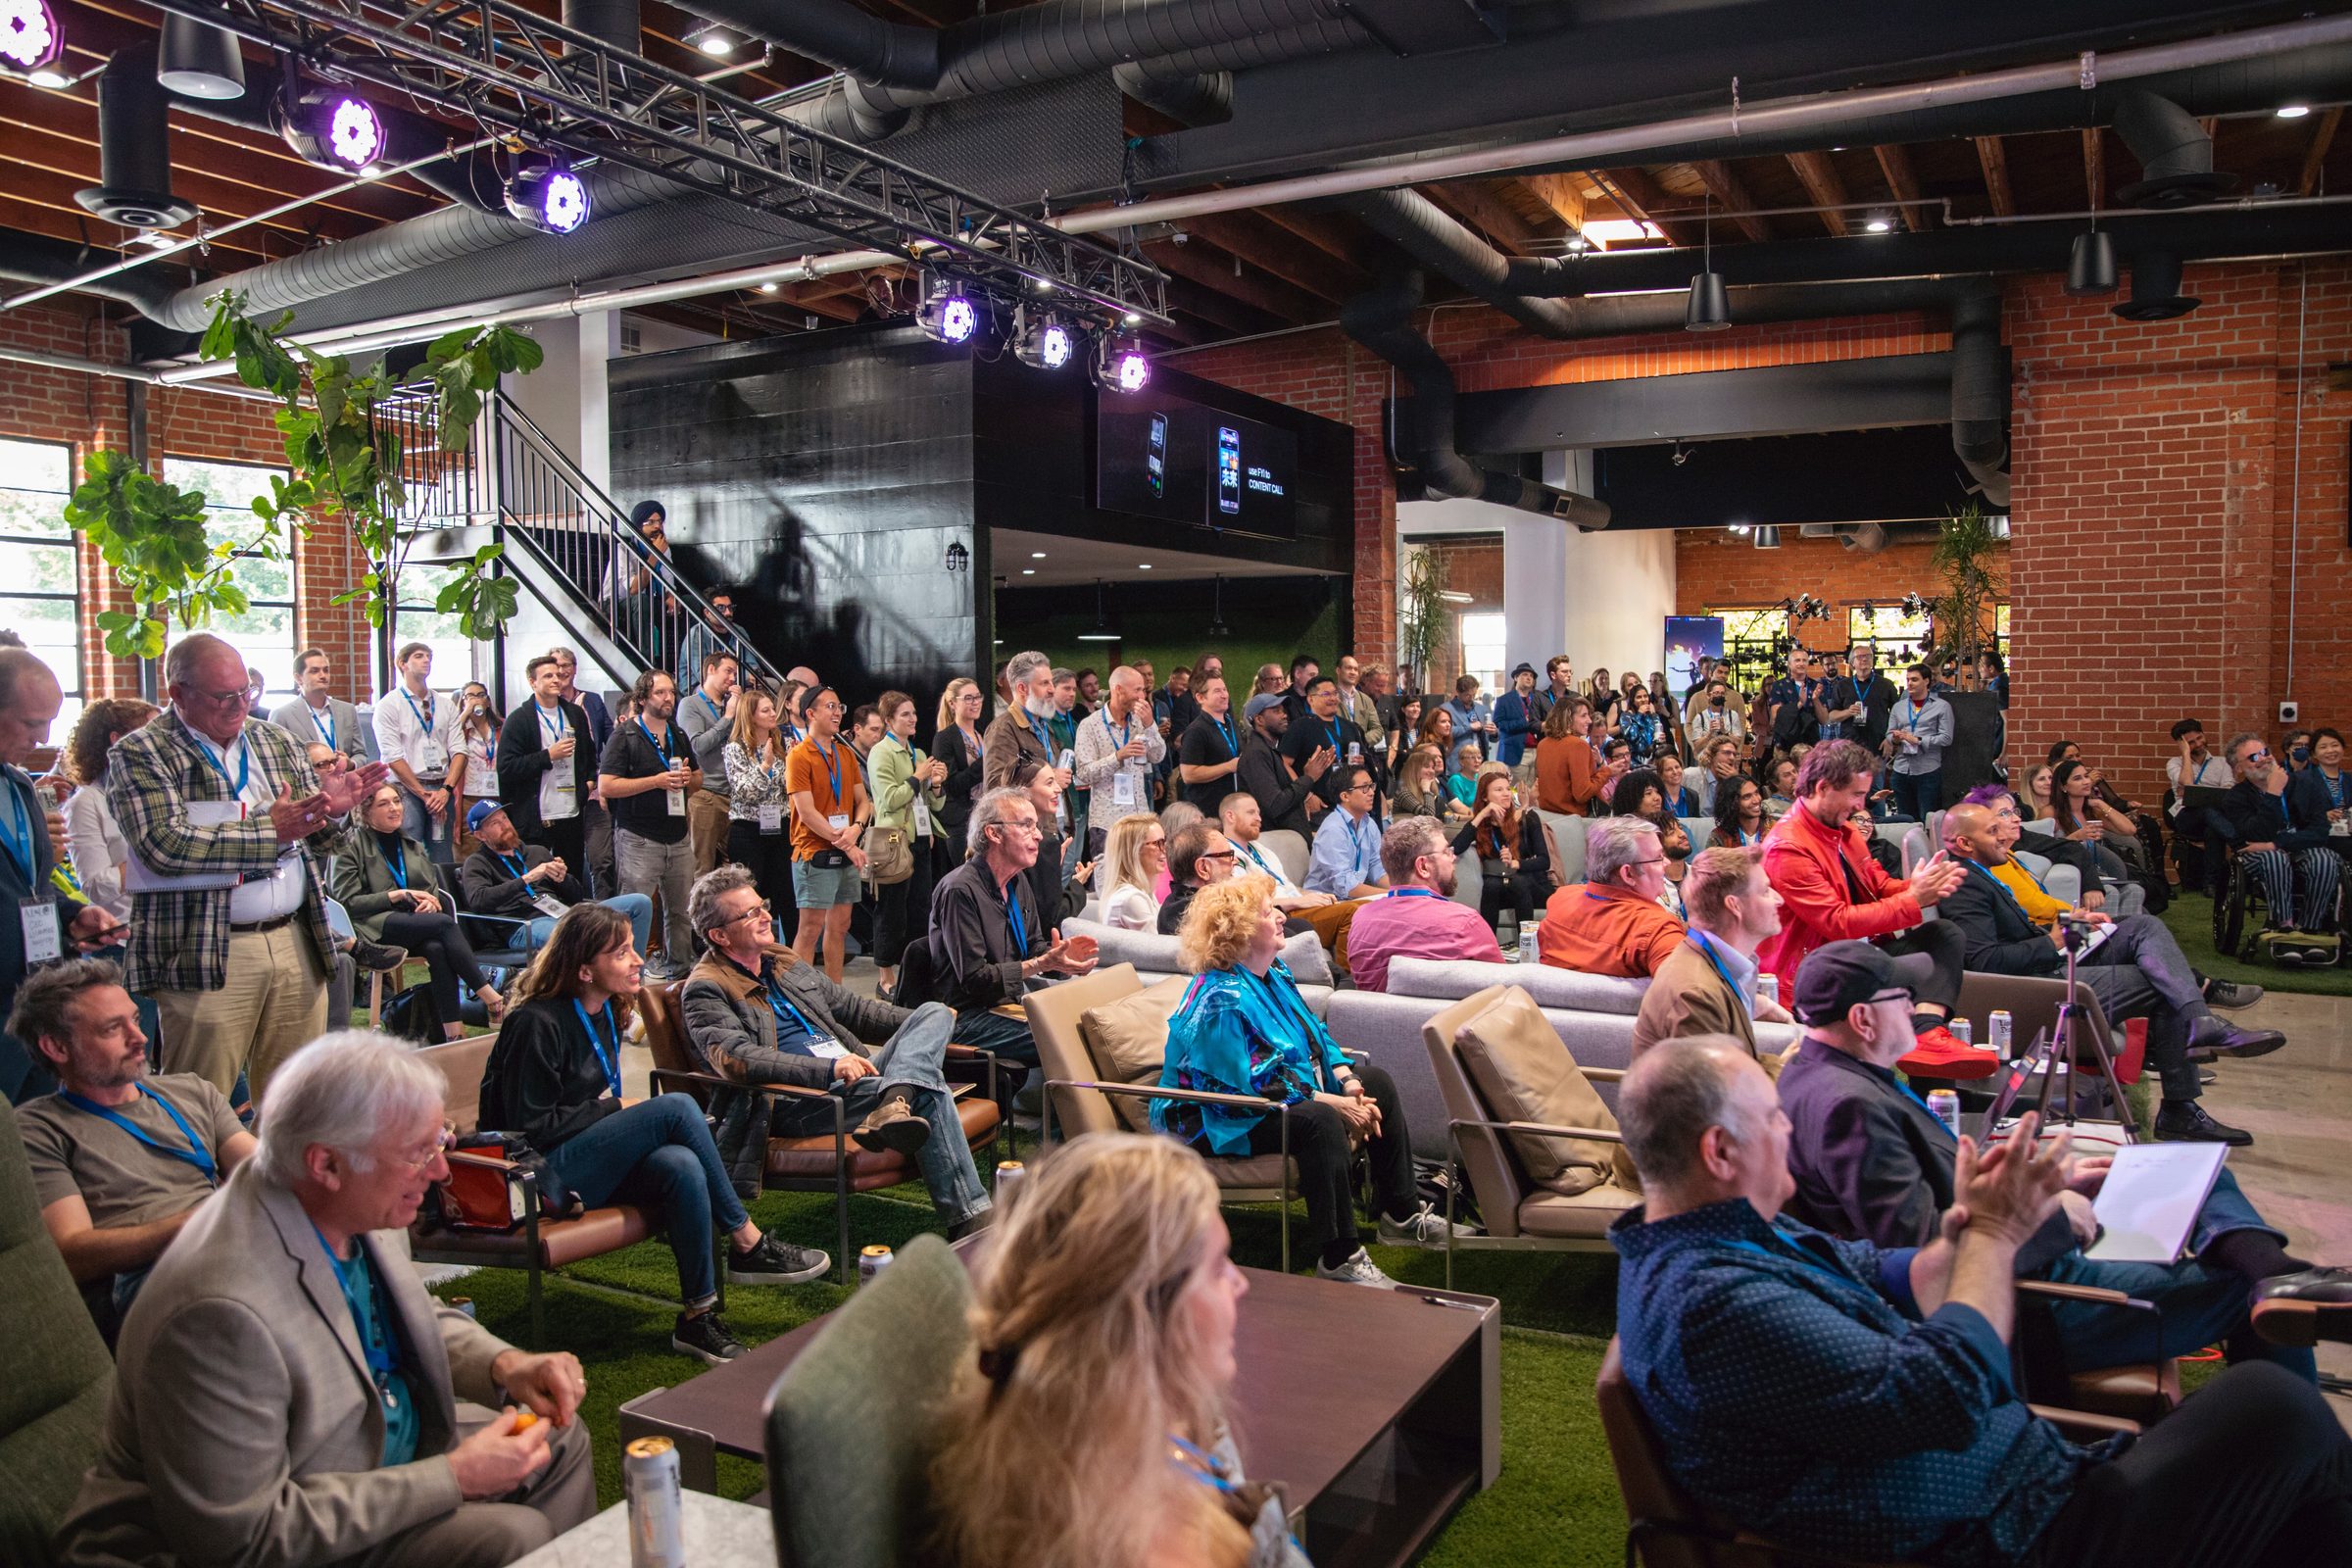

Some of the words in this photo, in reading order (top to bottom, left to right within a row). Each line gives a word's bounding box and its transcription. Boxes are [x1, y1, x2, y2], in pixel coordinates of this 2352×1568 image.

[1248, 467, 1257, 476] use
[1249, 479, 1271, 492] CONTENT
[1271, 484, 1285, 496] CALL
